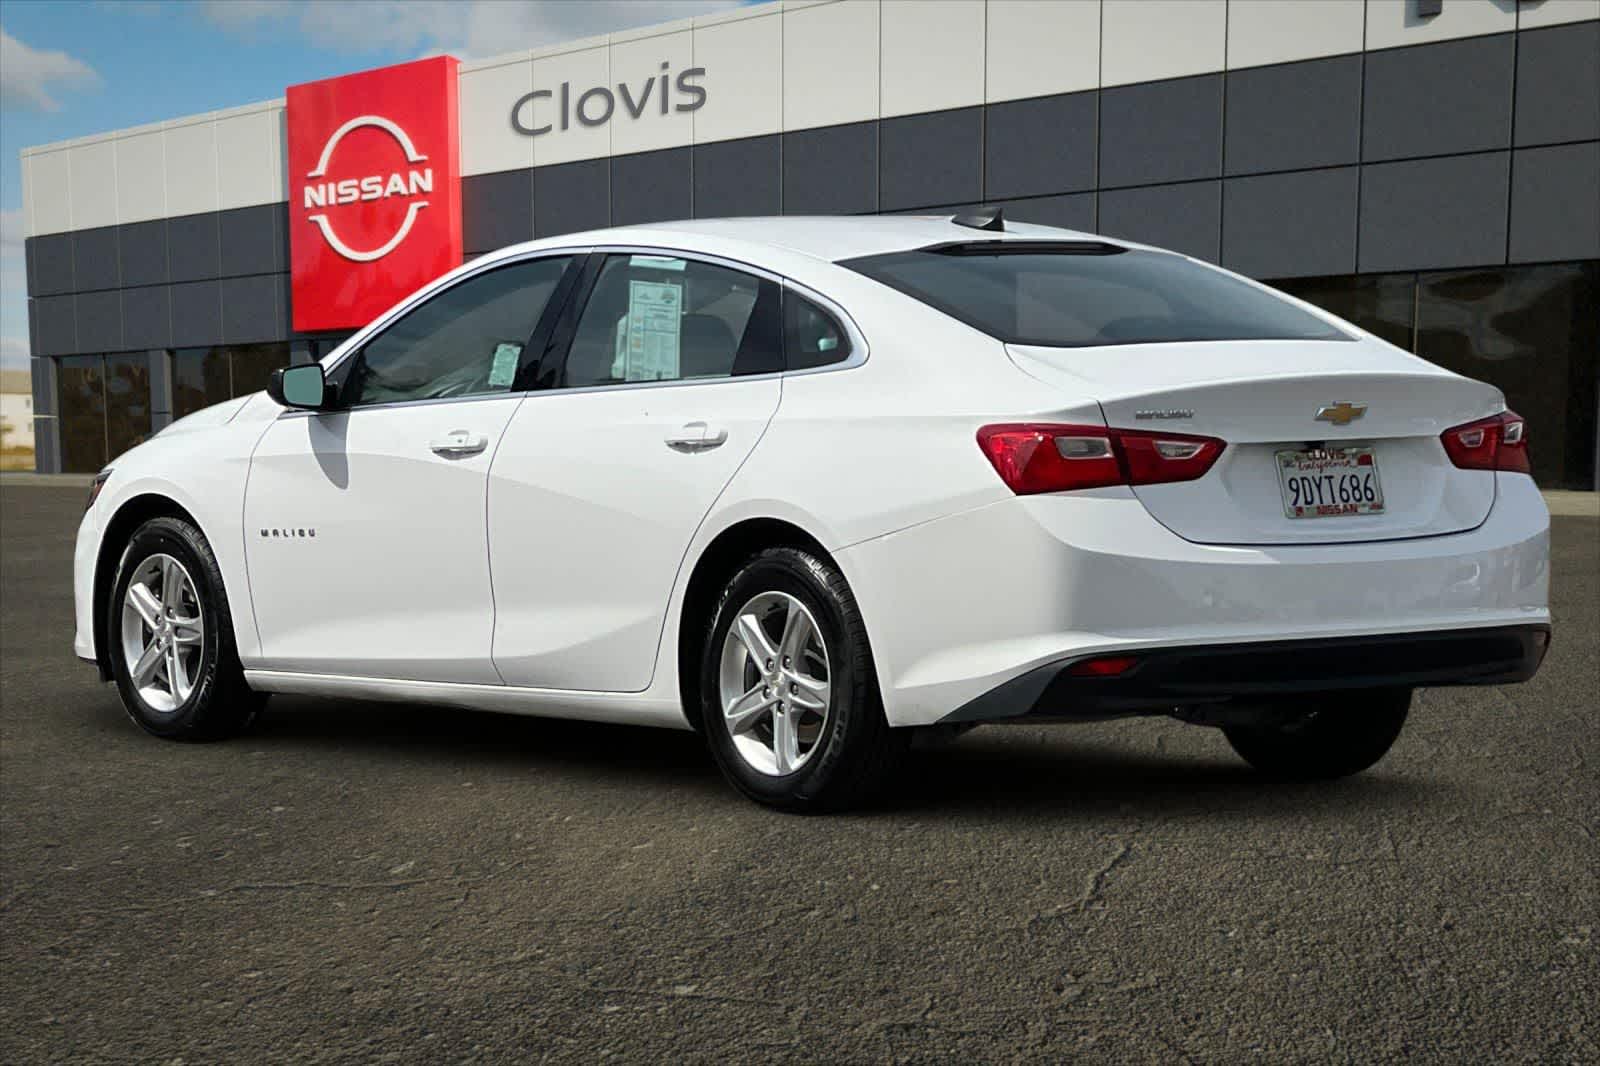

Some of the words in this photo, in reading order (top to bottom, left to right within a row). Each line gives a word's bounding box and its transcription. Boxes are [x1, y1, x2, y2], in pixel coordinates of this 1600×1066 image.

[511, 61, 707, 136] Clovis
[303, 168, 433, 208] NISSAN
[1288, 474, 1375, 506] 9DYT686
[1316, 504, 1358, 515] NISSAN
[260, 528, 315, 537] MALIBU
